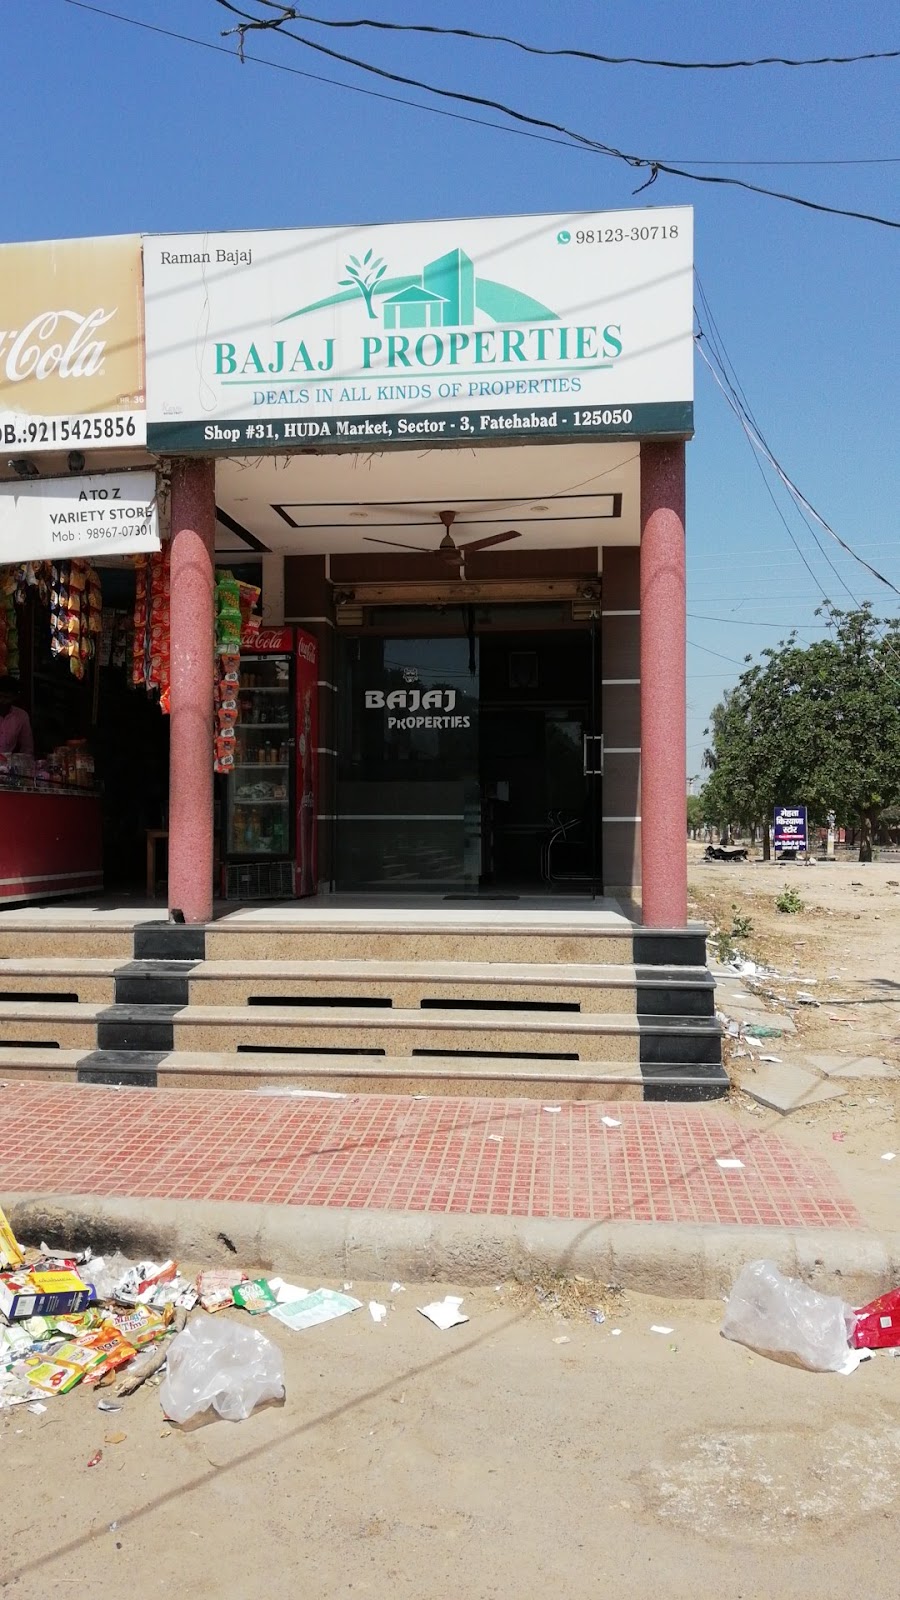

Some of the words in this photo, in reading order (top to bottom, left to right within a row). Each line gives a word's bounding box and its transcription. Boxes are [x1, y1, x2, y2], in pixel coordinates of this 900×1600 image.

[576, 225, 679, 245] 98123-30718
[160, 251, 211, 265] Raman
[215, 249, 253, 266] Bajaj
[214, 338, 336, 375] BAJAJ
[360, 324, 623, 369] PROPERTIES
[133, 396, 144, 404] 36
[253, 389, 310, 406] DEALS
[316, 388, 334, 403] IN
[339, 387, 371, 402] ALL
[377, 384, 432, 401] KINDS
[438, 382, 462, 398] OF
[468, 377, 582, 397] PROPERTIES
[0, 415, 136, 445] B.:9215425856
[204, 424, 241, 442] Shop
[245, 423, 280, 441] #31,
[284, 422, 332, 438] HUDA
[336, 419, 392, 438] Market,
[397, 417, 446, 433] Sector
[460, 417, 475, 433] 3,
[480, 412, 557, 430] Fatehabad
[573, 409, 633, 427] 125050
[79, 491, 88, 501] A
[89, 489, 108, 500] TO
[112, 488, 121, 499] Z
[50, 510, 105, 524] VARIETY
[109, 507, 153, 520] STORE
[86, 524, 152, 540] 98967-07301
[365, 690, 457, 712] BAJAJ
[387, 716, 471, 731] PROPERTIES
